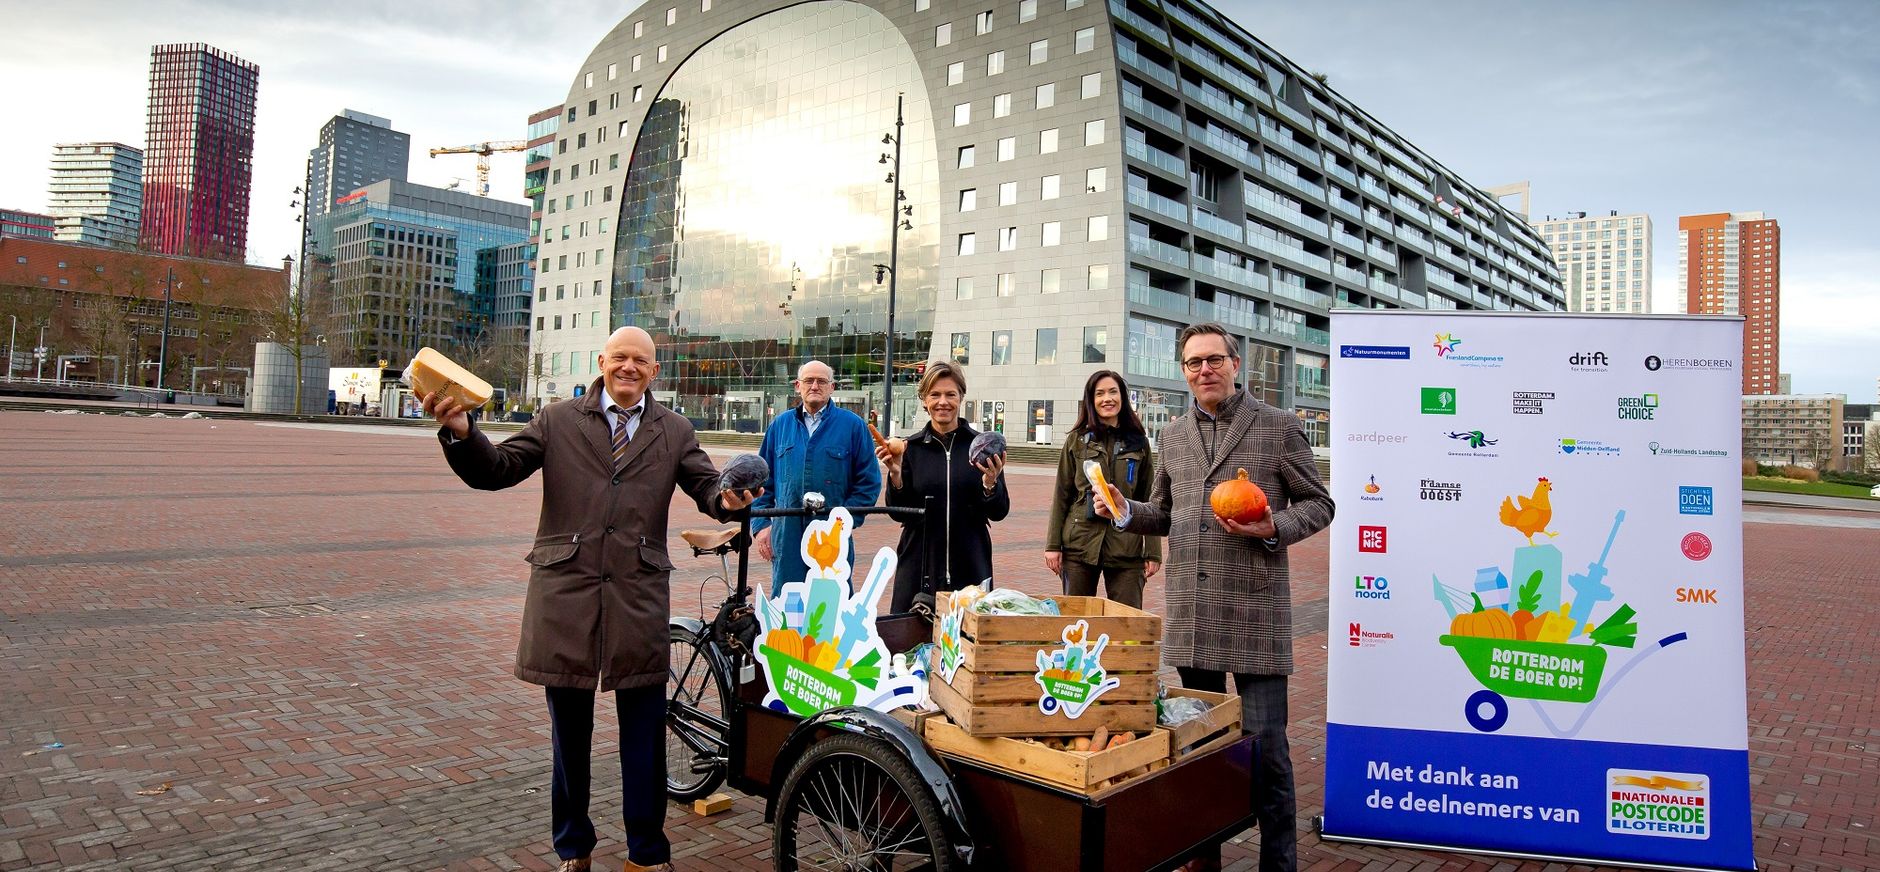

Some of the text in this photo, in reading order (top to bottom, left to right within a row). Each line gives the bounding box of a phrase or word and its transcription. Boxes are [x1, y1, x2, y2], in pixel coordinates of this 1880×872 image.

[1569, 351, 1608, 366] drift
[1662, 358, 1733, 368] HERENBOEREN
[1617, 397, 1644, 408] GREEN
[1618, 407, 1654, 420] CHOICE
[1348, 431, 1408, 445] aardpeer
[1420, 489, 1462, 501] OOGST
[1681, 494, 1711, 505] DOEN
[1363, 530, 1383, 540] PIC
[1355, 576, 1388, 591] LTO
[1355, 590, 1391, 600] noord
[1676, 587, 1718, 604] SMK
[1361, 631, 1394, 639] Naturalis
[1492, 647, 1585, 675] ROTTERDAM
[786, 664, 842, 704] ROTTERDAM
[1489, 664, 1584, 691] DE BOER OP!
[783, 678, 796, 695] DE
[797, 687, 821, 710] BOER
[1366, 761, 1519, 789] Met dank aan
[1366, 789, 1580, 823] de deelnemers van
[1621, 792, 1694, 806] NATIONALE
[1612, 802, 1705, 824] POSTCODE
[1622, 820, 1694, 833] LOTERIJ
